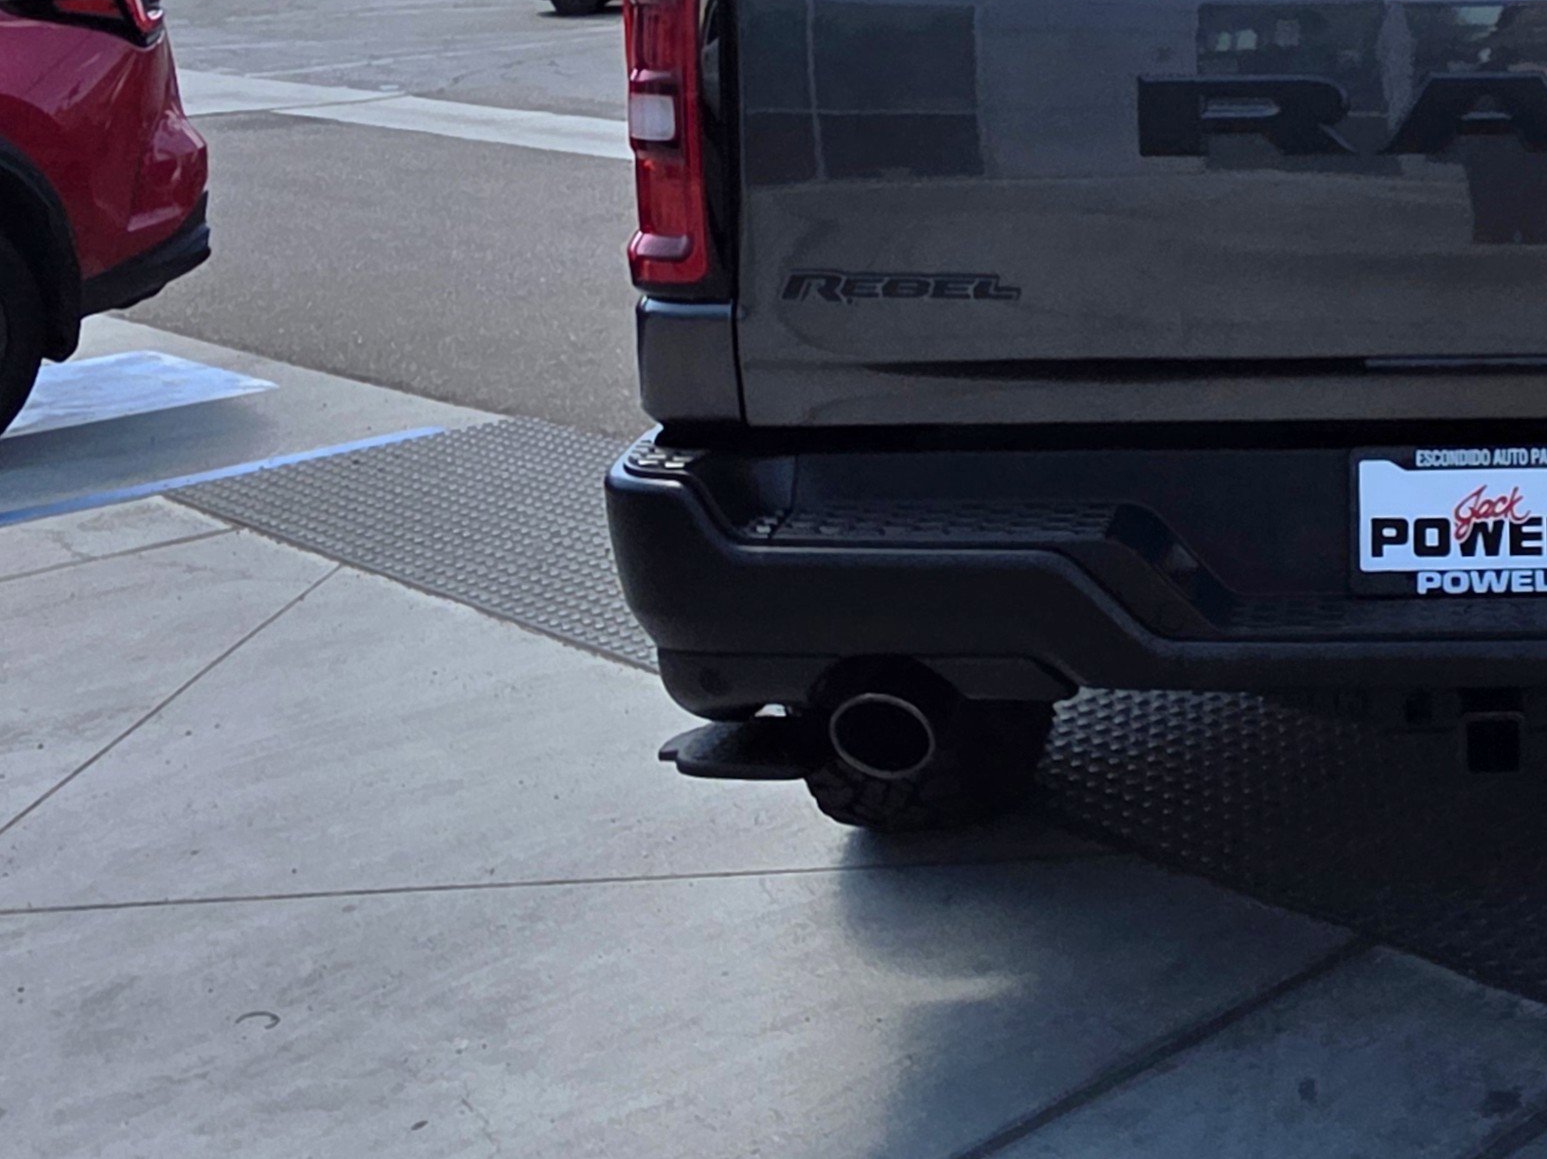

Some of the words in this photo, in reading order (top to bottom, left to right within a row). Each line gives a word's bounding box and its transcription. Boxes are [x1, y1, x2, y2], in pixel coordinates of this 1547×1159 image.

[781, 268, 1022, 304] REBEL
[1415, 449, 1491, 467] ESCONDIDO
[1492, 448, 1529, 466] AUTO
[1454, 484, 1531, 541] Jack
